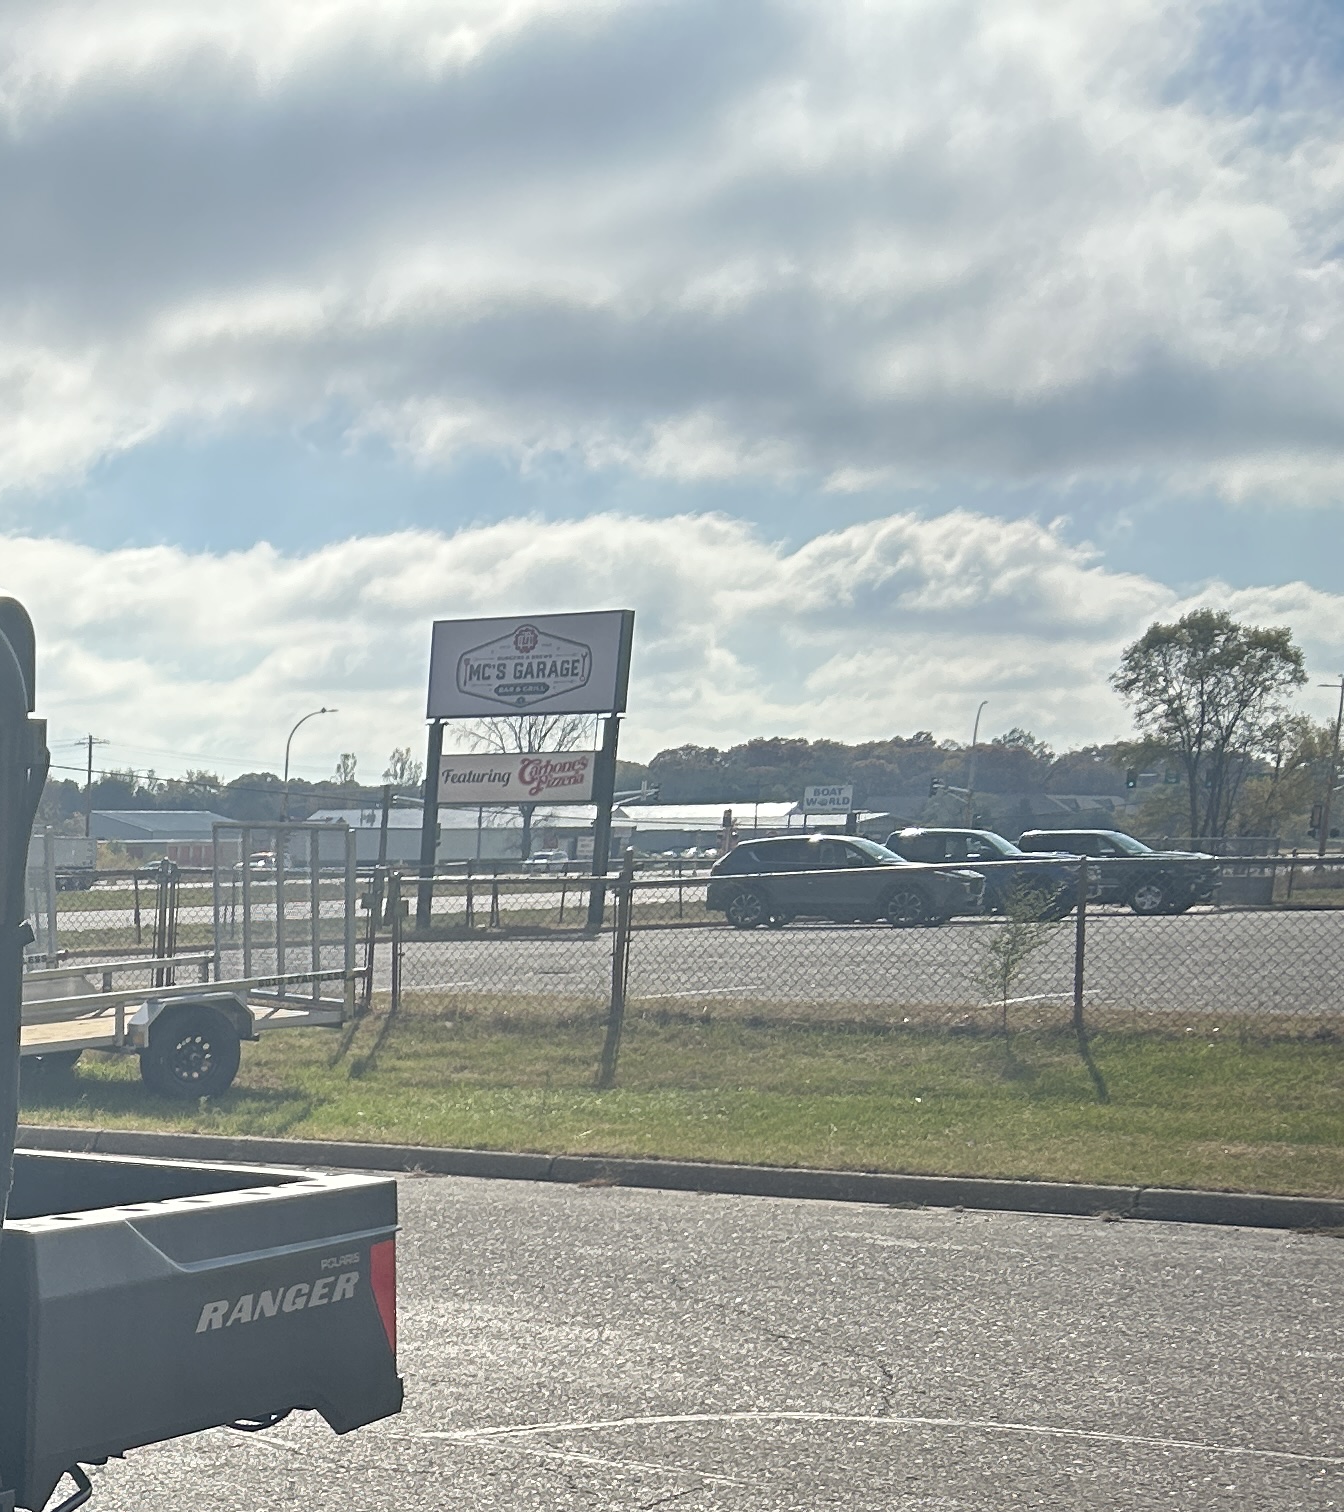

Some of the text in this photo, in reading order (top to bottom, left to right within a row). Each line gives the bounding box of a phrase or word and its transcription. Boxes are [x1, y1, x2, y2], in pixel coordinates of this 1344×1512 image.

[468, 659, 580, 681] MC'S GARAGE
[442, 755, 590, 787] Featuring Carbone's
[528, 773, 584, 796] Pizzeria
[814, 787, 844, 796] BOAT
[321, 1252, 360, 1270] POLARIS
[195, 1271, 360, 1334] RANGER
